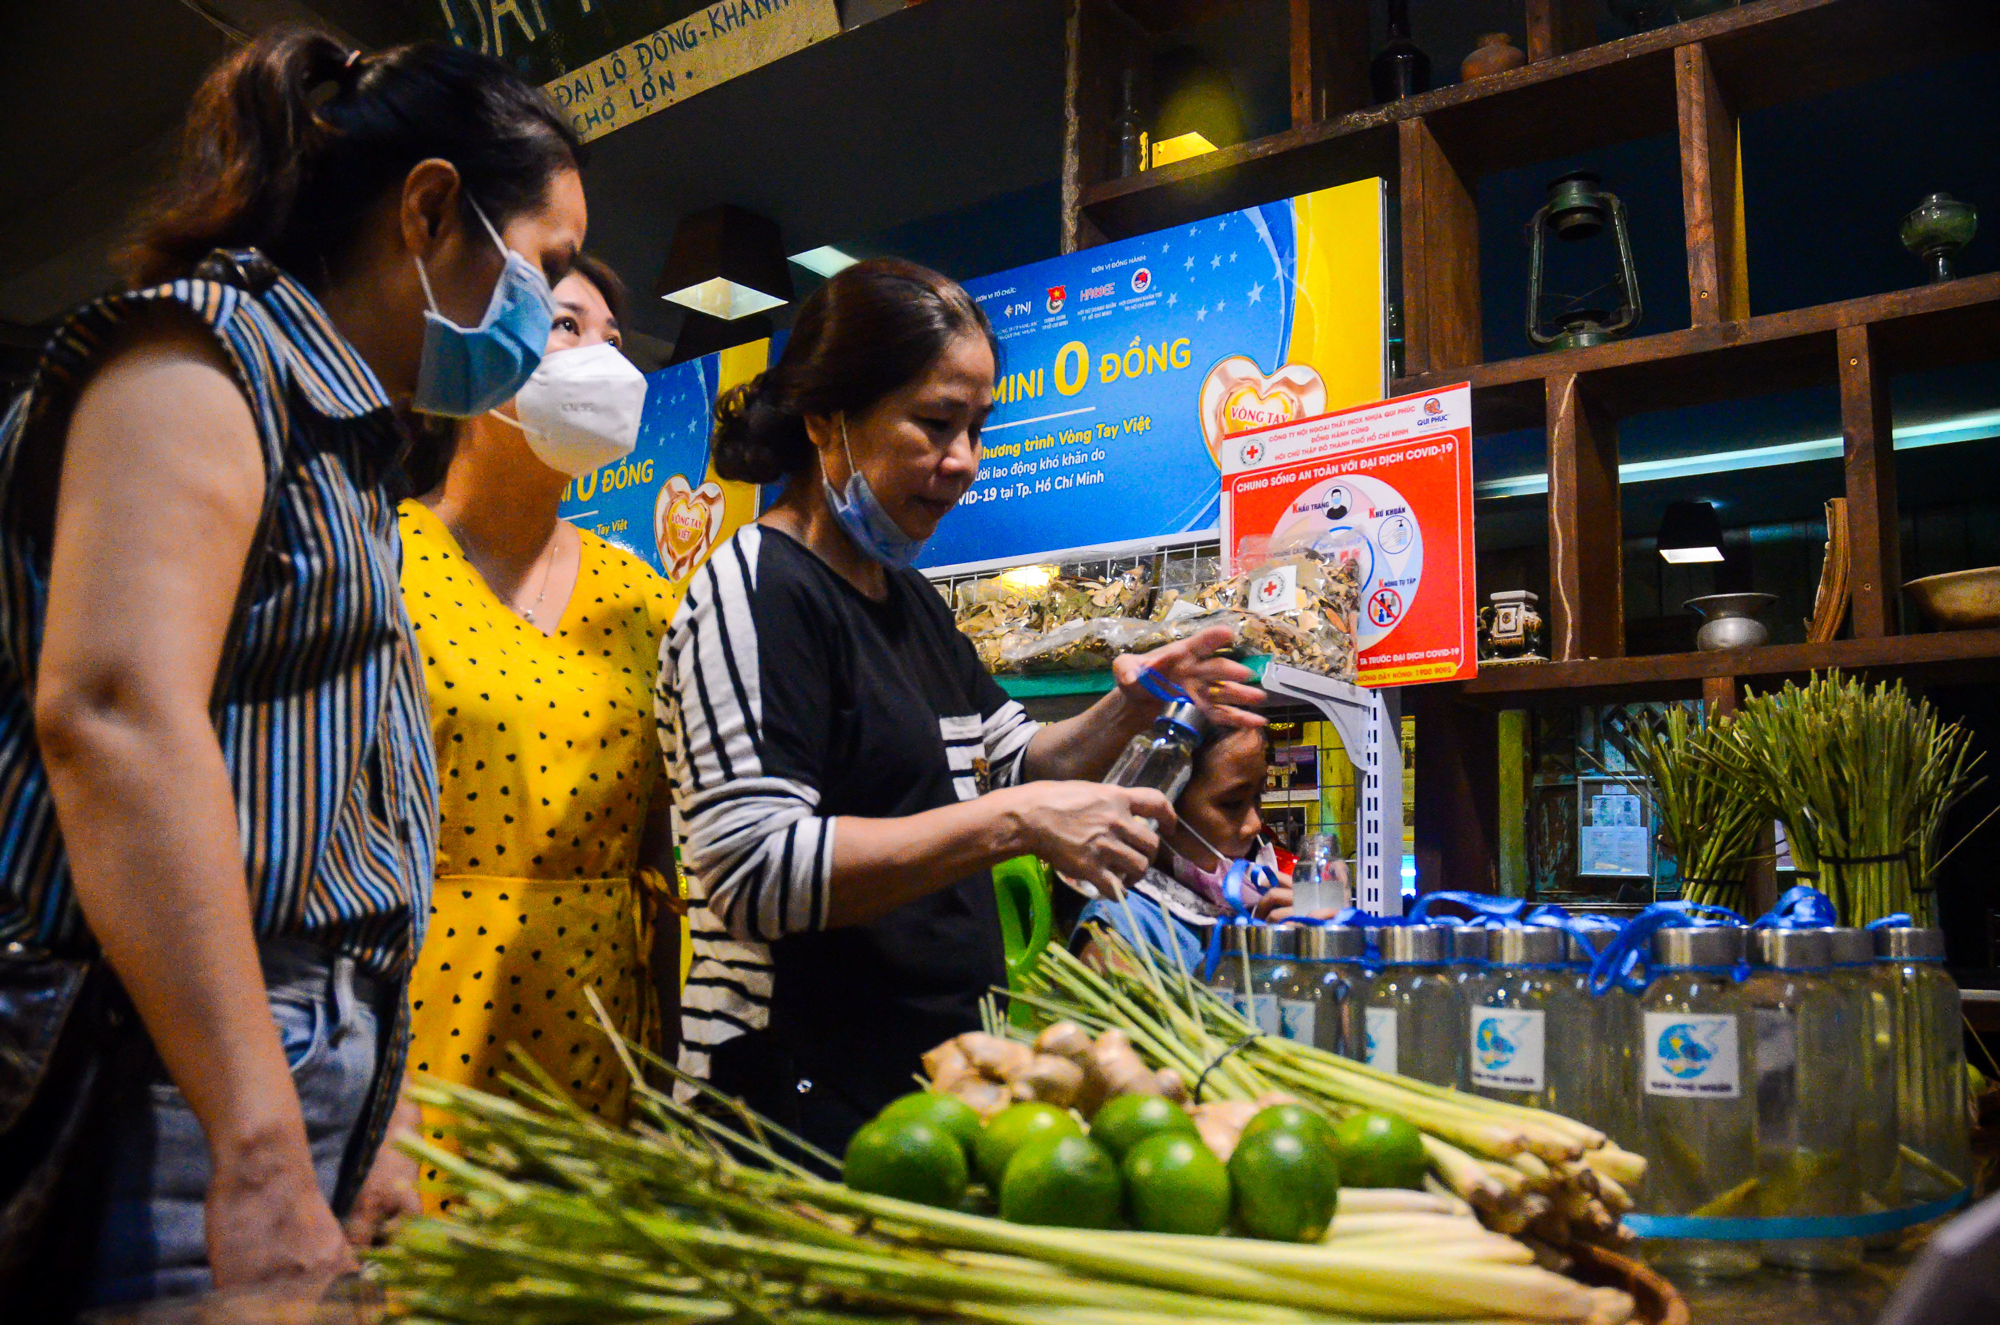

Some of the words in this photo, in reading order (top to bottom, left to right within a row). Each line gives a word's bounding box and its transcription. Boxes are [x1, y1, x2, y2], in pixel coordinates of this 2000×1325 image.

[553, 73, 595, 108] ĐẠI
[600, 52, 627, 88] LỘ
[572, 96, 616, 136] CHỢ
[630, 68, 676, 109] LỚN
[1014, 300, 1032, 316] PNJ
[991, 368, 1044, 404] MINI
[1054, 340, 1090, 396] 0
[1098, 335, 1191, 383] ĐỒNG
[1230, 406, 1265, 423] VÒNG
[1267, 412, 1289, 424] TAY
[1268, 433, 1288, 443] CÔNG
[1347, 418, 1363, 426] INOX
[1384, 409, 1396, 418] QUI
[1397, 405, 1416, 415] PHÚC
[1391, 428, 1409, 437] MINH
[1417, 417, 1430, 427] QUI
[979, 442, 1021, 460] hương
[1024, 433, 1055, 452] trình
[1059, 429, 1092, 446] Vòng
[1096, 423, 1119, 439] Tay
[1123, 415, 1152, 436] Việt
[601, 456, 654, 493] ĐỒNG
[974, 468, 991, 482] ười
[992, 467, 1008, 480] lao
[1010, 461, 1037, 478] động
[1039, 454, 1060, 470] khó
[1062, 450, 1088, 467] khăn
[1091, 447, 1106, 462] do
[1236, 478, 1269, 493] CHUNG
[1270, 471, 1297, 487] SỐNG
[1298, 469, 1312, 481] AN
[1313, 462, 1339, 477] TOÀN
[1340, 459, 1358, 473] VỚI
[1360, 456, 1377, 470] ĐẠI
[1378, 451, 1404, 467] DỊCH
[1405, 442, 1454, 460] COVID-19
[958, 486, 997, 506] VID-19
[1000, 484, 1014, 501] tại
[1016, 482, 1032, 499] Tp.
[1035, 476, 1051, 494] Hồ
[1054, 472, 1074, 490] Chí
[1076, 469, 1105, 486] Minh
[597, 523, 611, 536] Tay
[611, 518, 628, 534] Việt
[1360, 657, 1368, 665] TA
[1425, 647, 1460, 659] COVID-19
